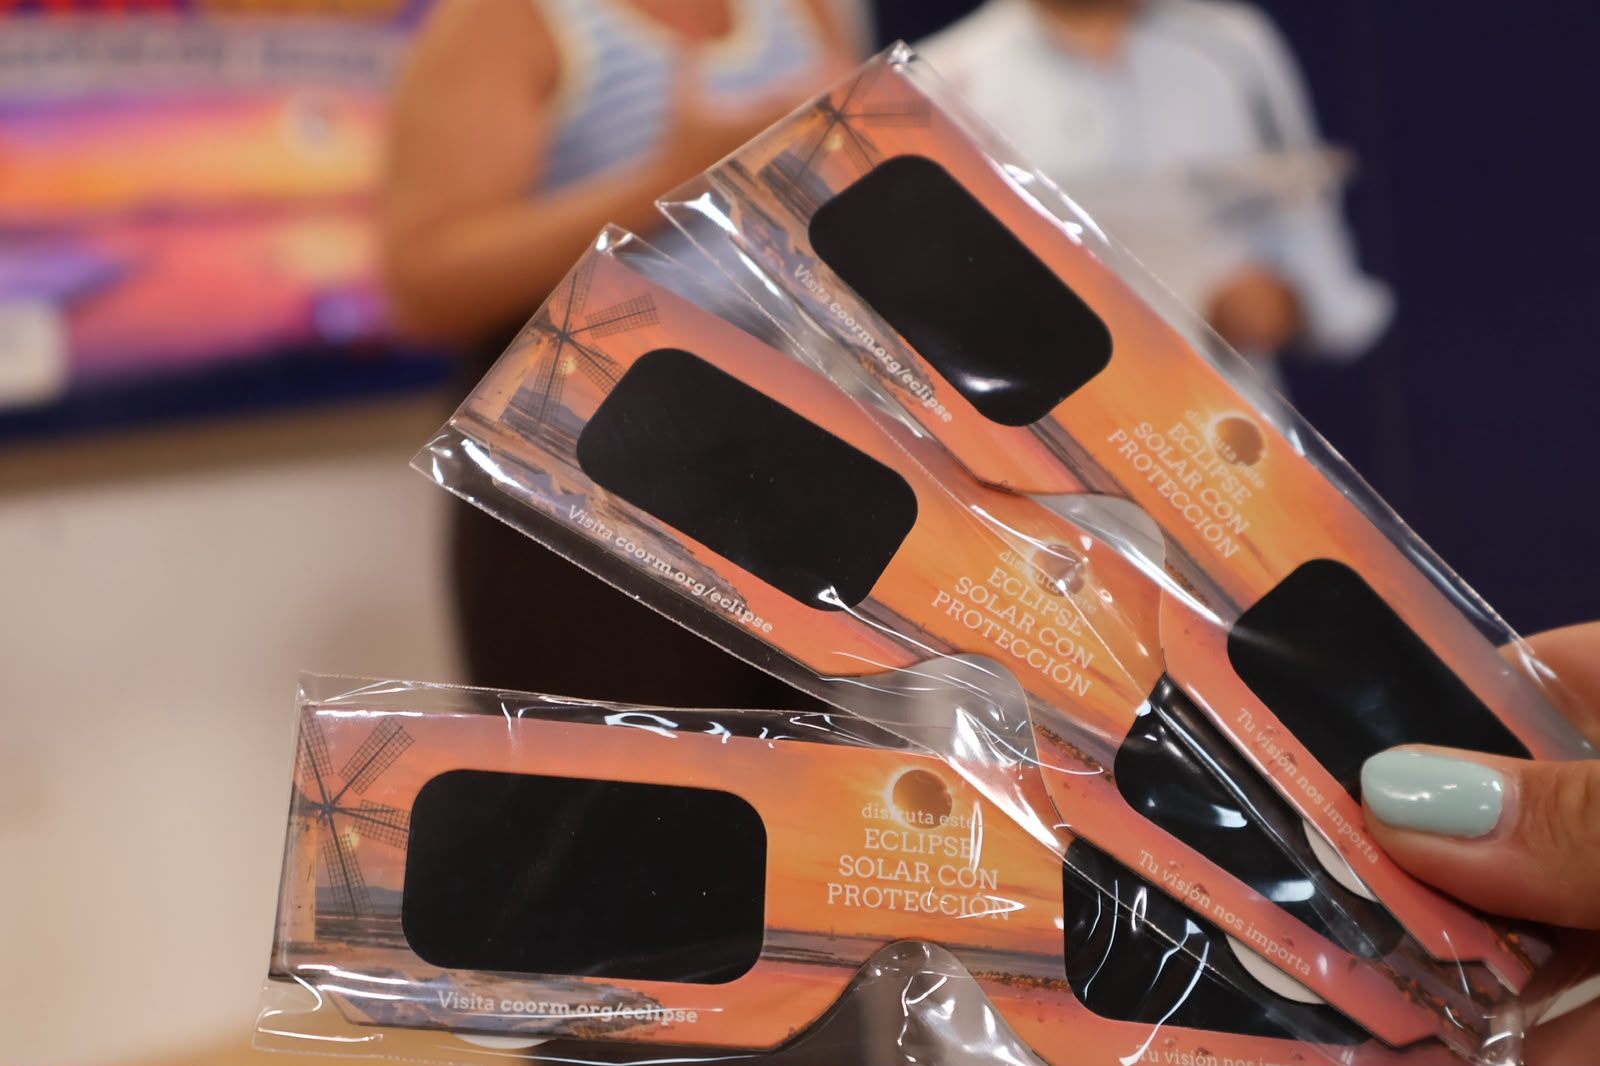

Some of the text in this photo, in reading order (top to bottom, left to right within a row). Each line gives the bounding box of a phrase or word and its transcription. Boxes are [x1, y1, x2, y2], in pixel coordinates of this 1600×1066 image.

[793, 263, 953, 422] Visita coorm.org/eclipse
[1107, 428, 1241, 559] PROTECCIÓN
[1134, 422, 1251, 535] SOLAR CON
[1167, 422, 1253, 505] ECLIPSE
[568, 504, 774, 633] Visita coorm.org/eclipse
[987, 567, 1087, 636] ECLIPSE
[931, 590, 1092, 697] PROTECCIÓN
[954, 576, 1095, 669] SOLAR CON
[1236, 708, 1380, 864] Tu visión nos importa
[838, 854, 999, 890] SOLAR CON
[864, 828, 974, 859] ECLIPSE
[827, 882, 1010, 921] PROTECCIÓN
[1139, 850, 1312, 976] Tu visión nos importa
[437, 990, 699, 1026] Visita coorm.org/eclipse
[1164, 1049, 1218, 1066] visión
